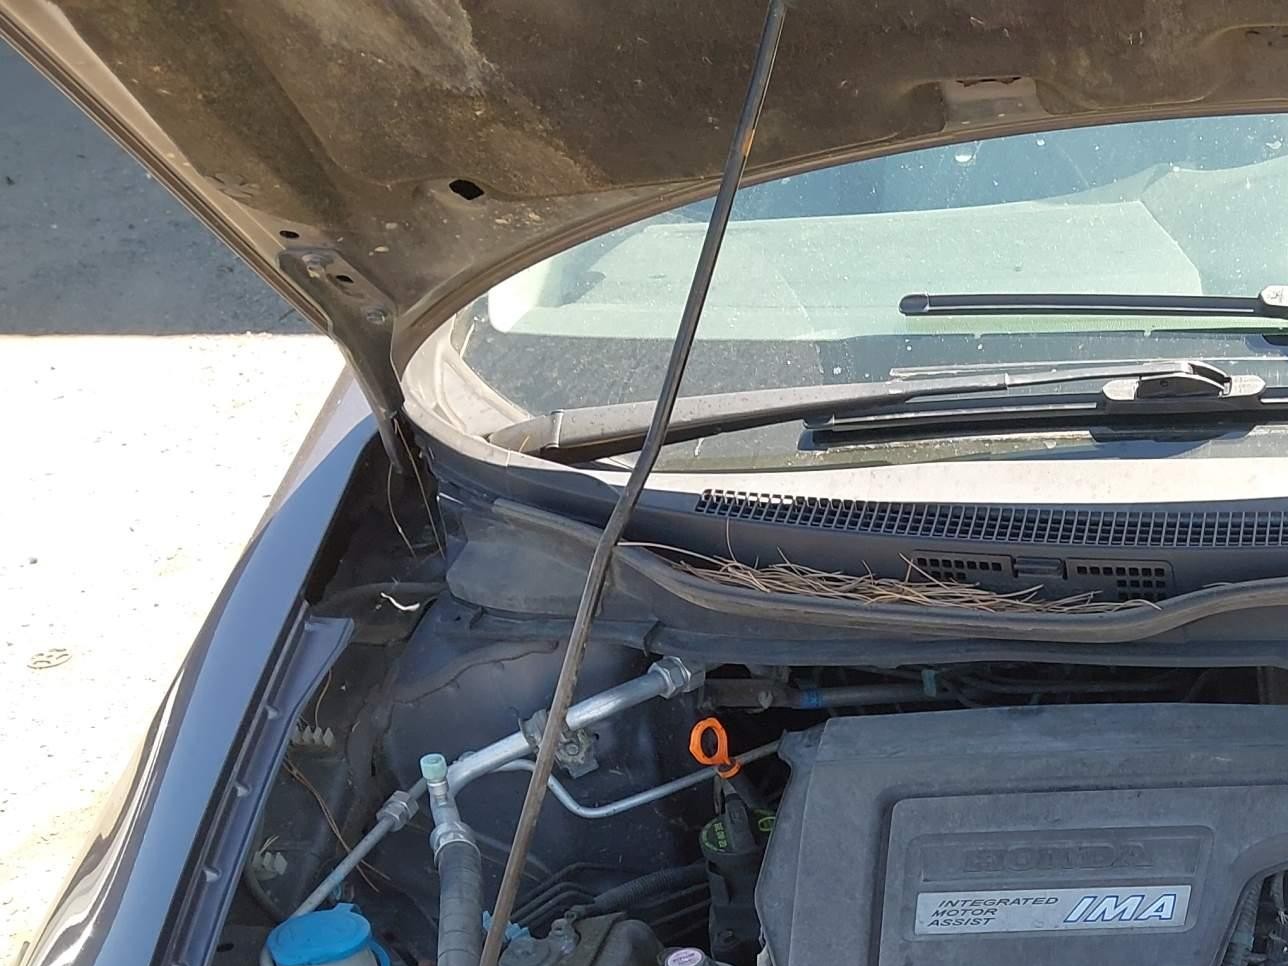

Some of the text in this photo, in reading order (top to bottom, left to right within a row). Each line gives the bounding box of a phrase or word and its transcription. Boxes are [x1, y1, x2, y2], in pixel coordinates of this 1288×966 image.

[964, 841, 1153, 872] HONDA
[938, 896, 1059, 908] INTEGRATED
[931, 907, 998, 917] MOTOR
[1064, 894, 1177, 923] IMA
[927, 917, 996, 927] ASSIST
